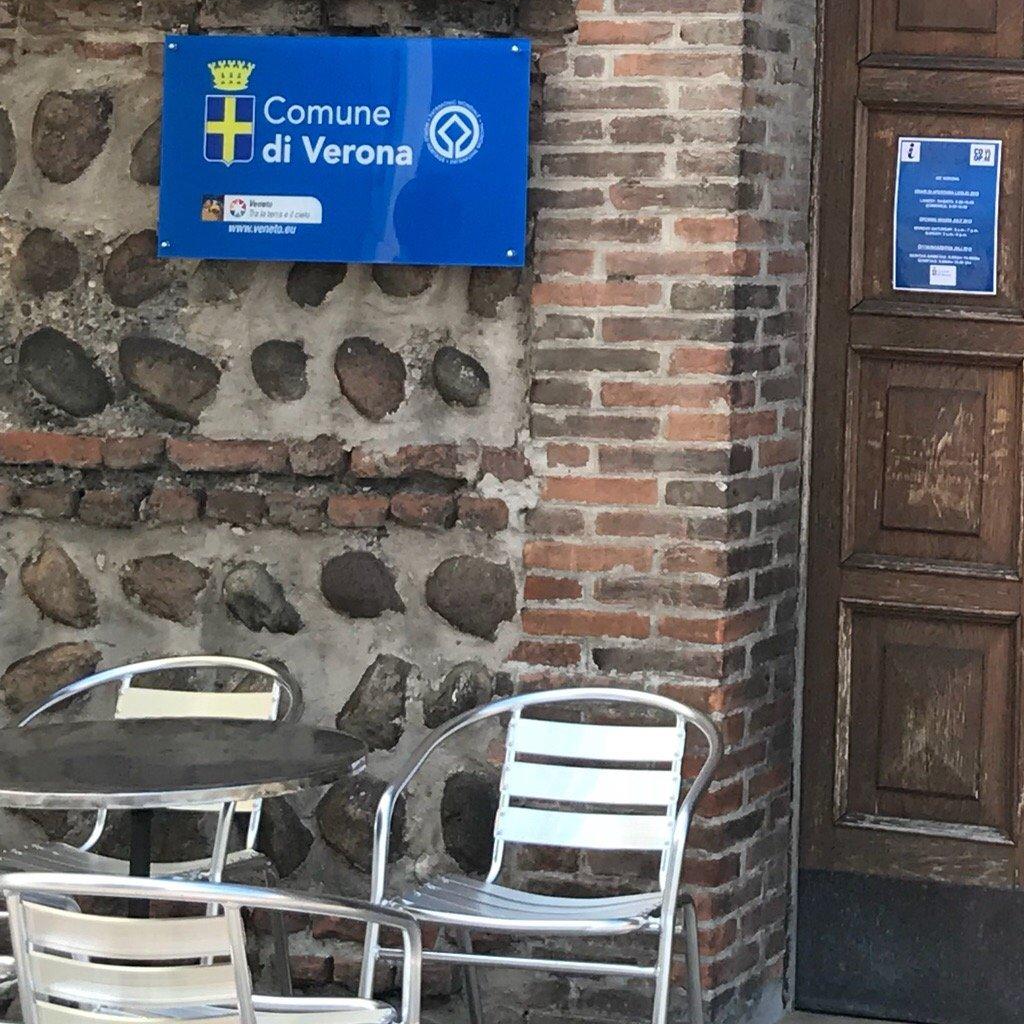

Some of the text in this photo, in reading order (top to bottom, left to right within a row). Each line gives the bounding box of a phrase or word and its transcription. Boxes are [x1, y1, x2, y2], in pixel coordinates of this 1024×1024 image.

[263, 95, 391, 126] Comune
[262, 133, 413, 166] di Verona
[249, 199, 273, 208] Veneto
[228, 224, 296, 234] www.veneto.eu
